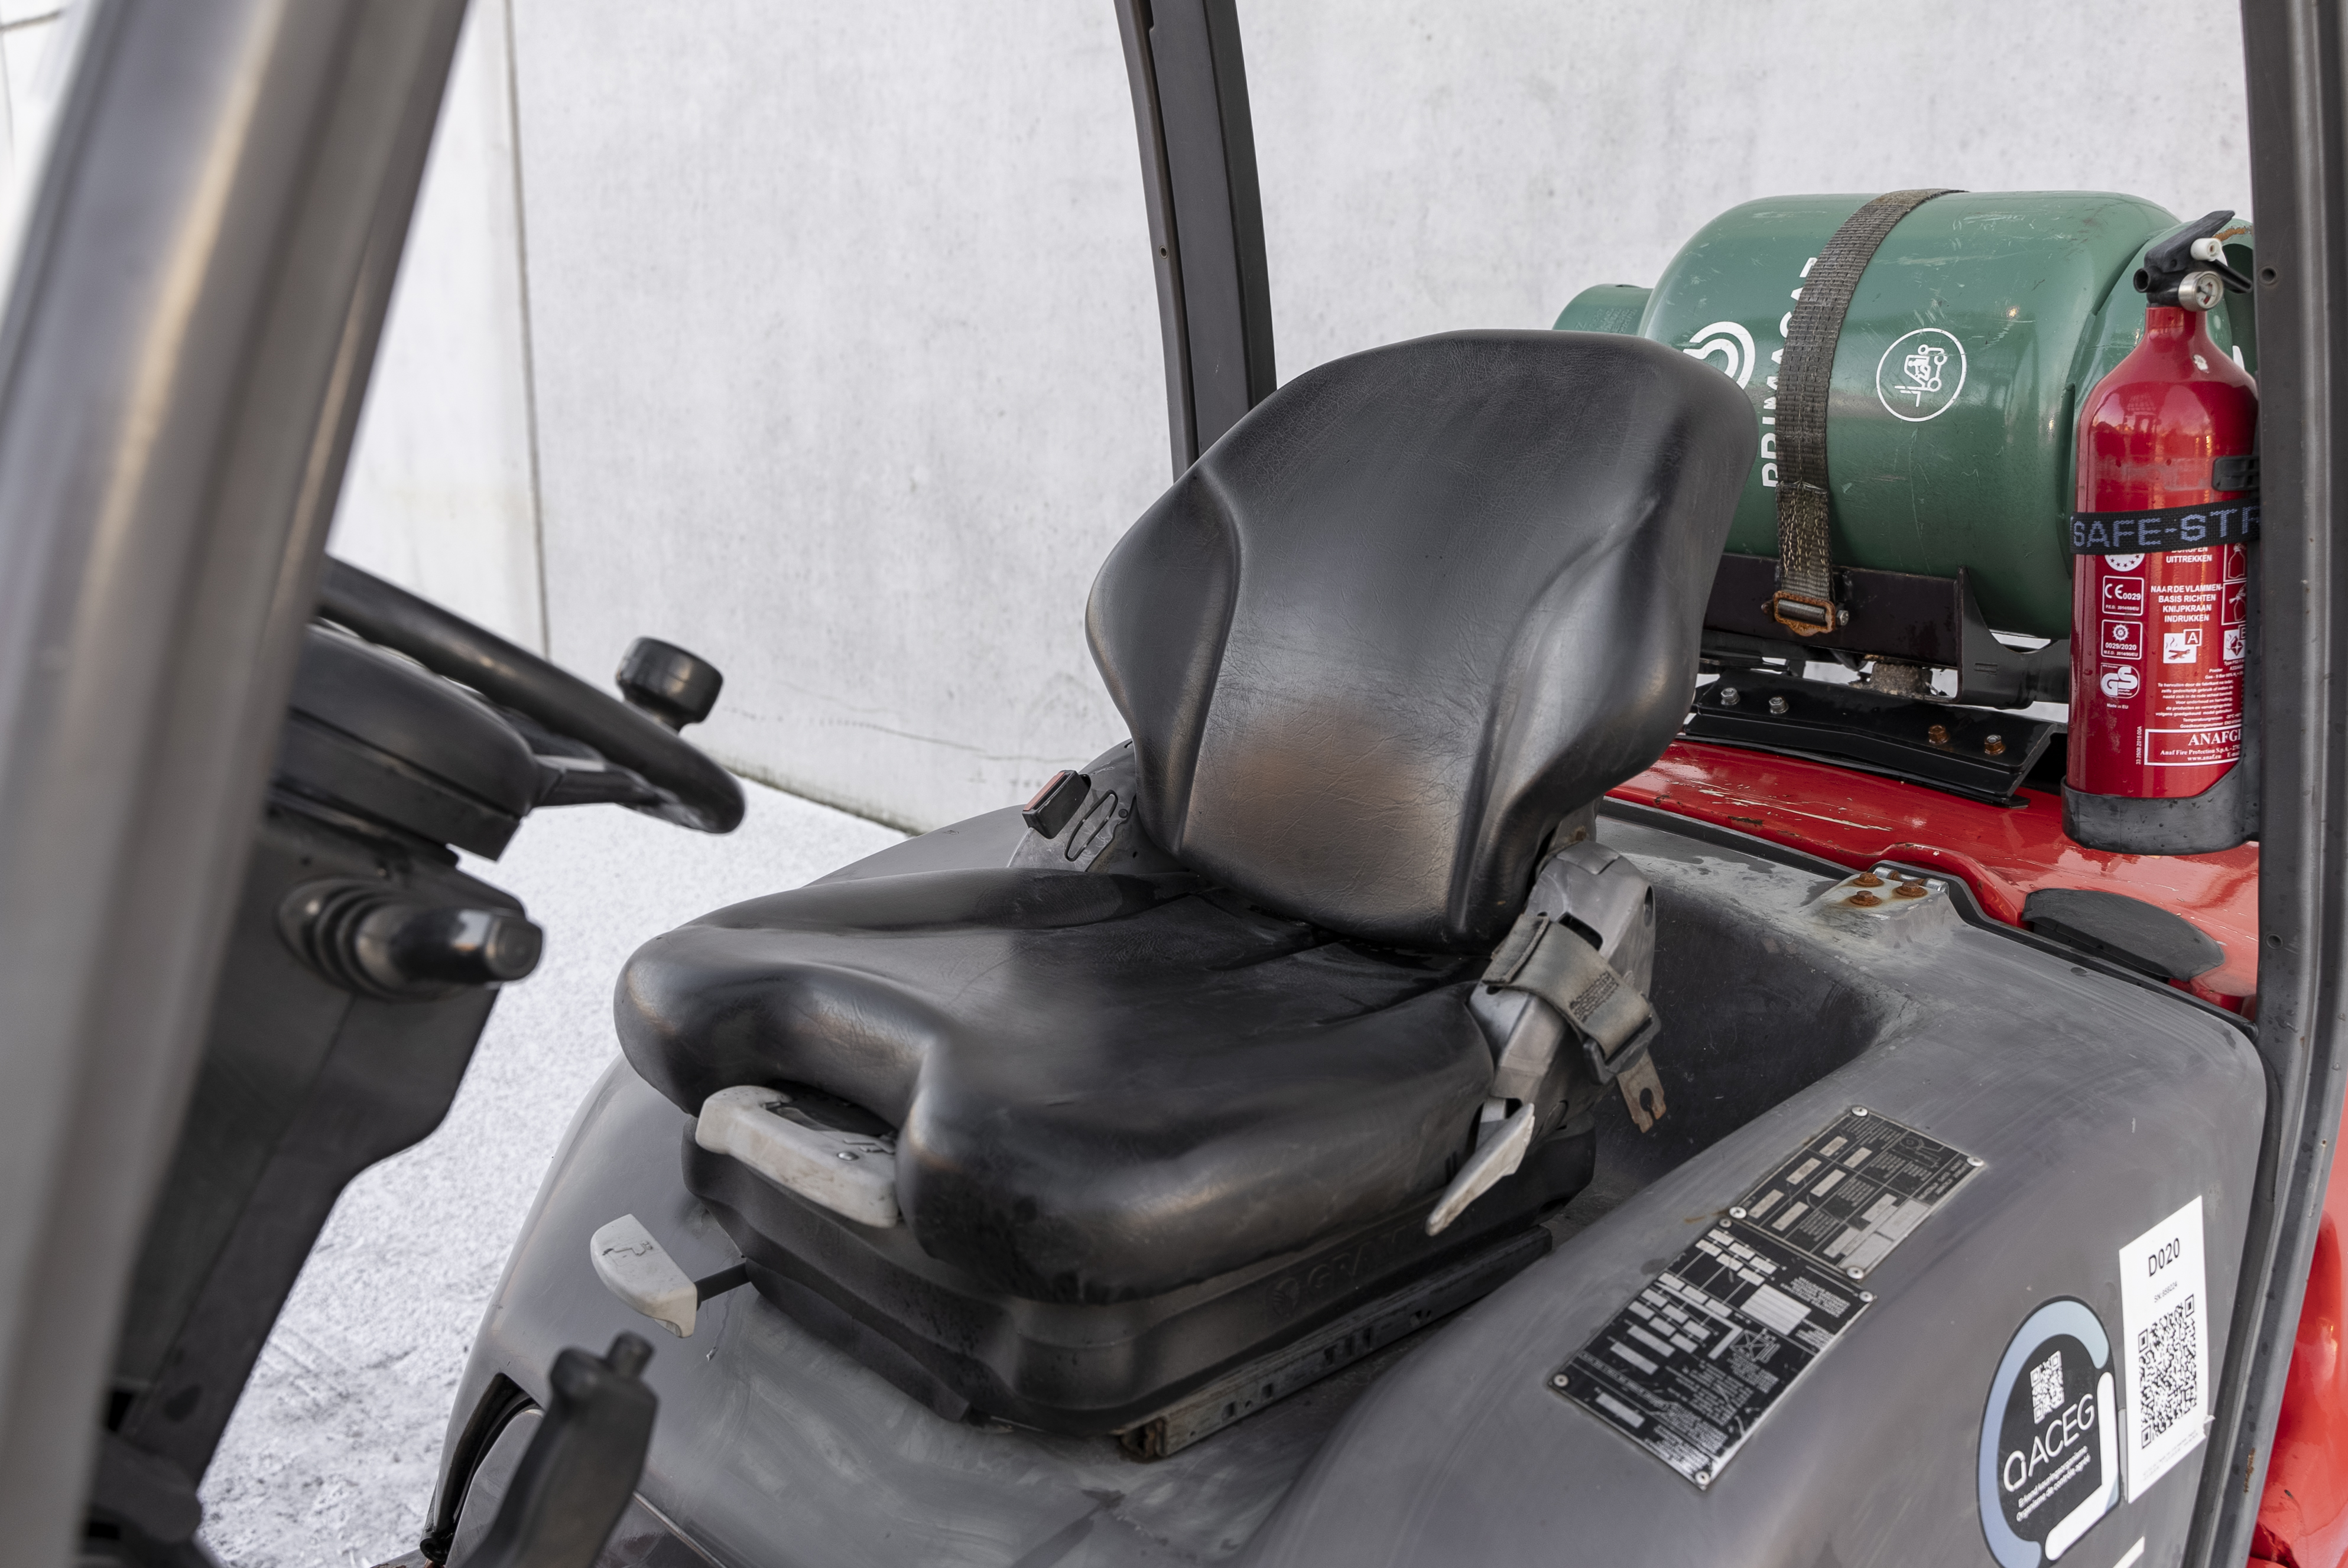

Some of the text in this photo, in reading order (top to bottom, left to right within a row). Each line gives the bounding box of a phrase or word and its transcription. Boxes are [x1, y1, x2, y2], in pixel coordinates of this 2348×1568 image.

[2166, 555, 2213, 563] UITTREKKEN
[2185, 584, 2223, 592] VLAMMEN-
[2184, 594, 2216, 603] RICHTEN
[2162, 604, 2211, 613] KNIJPKRAAN
[2164, 614, 2210, 623] INDRUKKEN
[2187, 632, 2198, 644] A
[2148, 1238, 2180, 1277] D020
